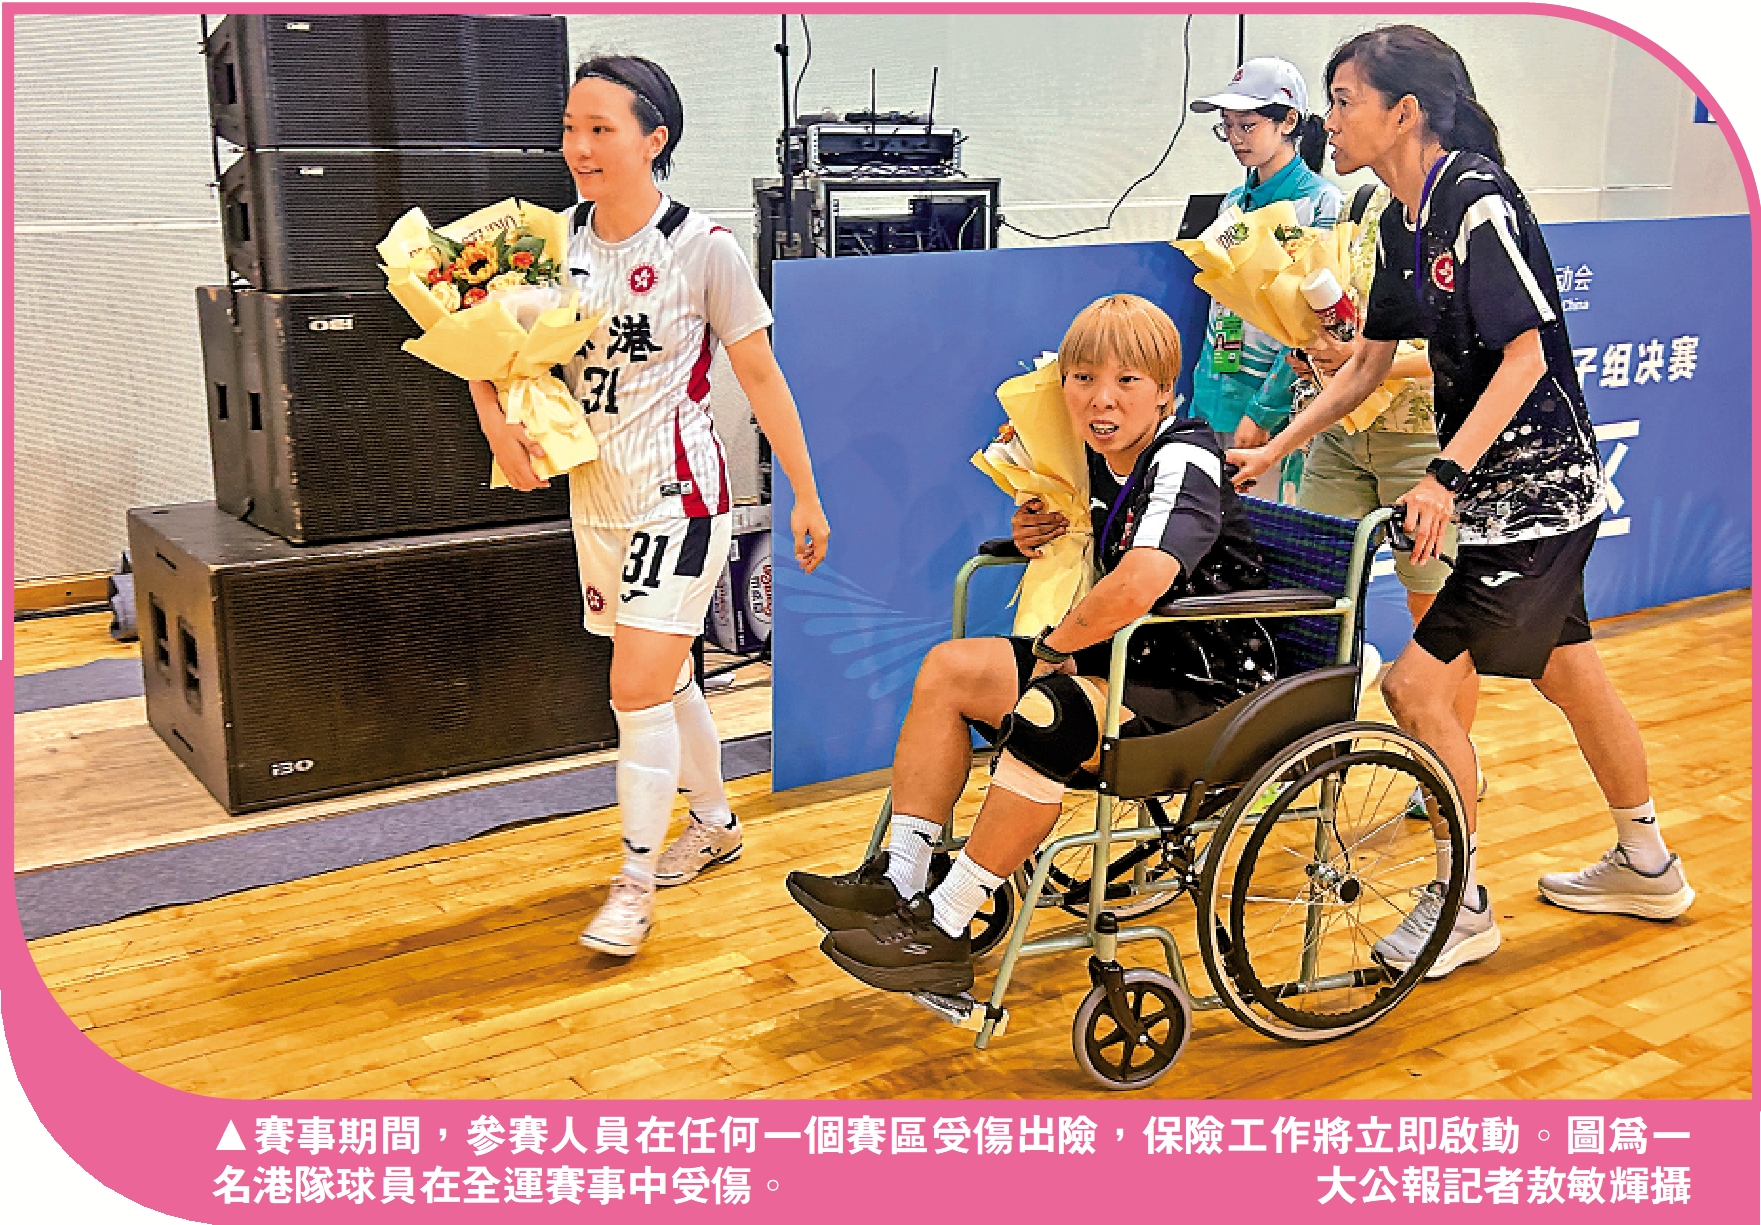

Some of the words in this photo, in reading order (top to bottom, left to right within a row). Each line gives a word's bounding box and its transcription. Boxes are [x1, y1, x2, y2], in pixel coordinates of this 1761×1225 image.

[1573, 335, 1699, 387] 子组决赛
[581, 366, 620, 414] 31
[622, 530, 669, 588] 31
